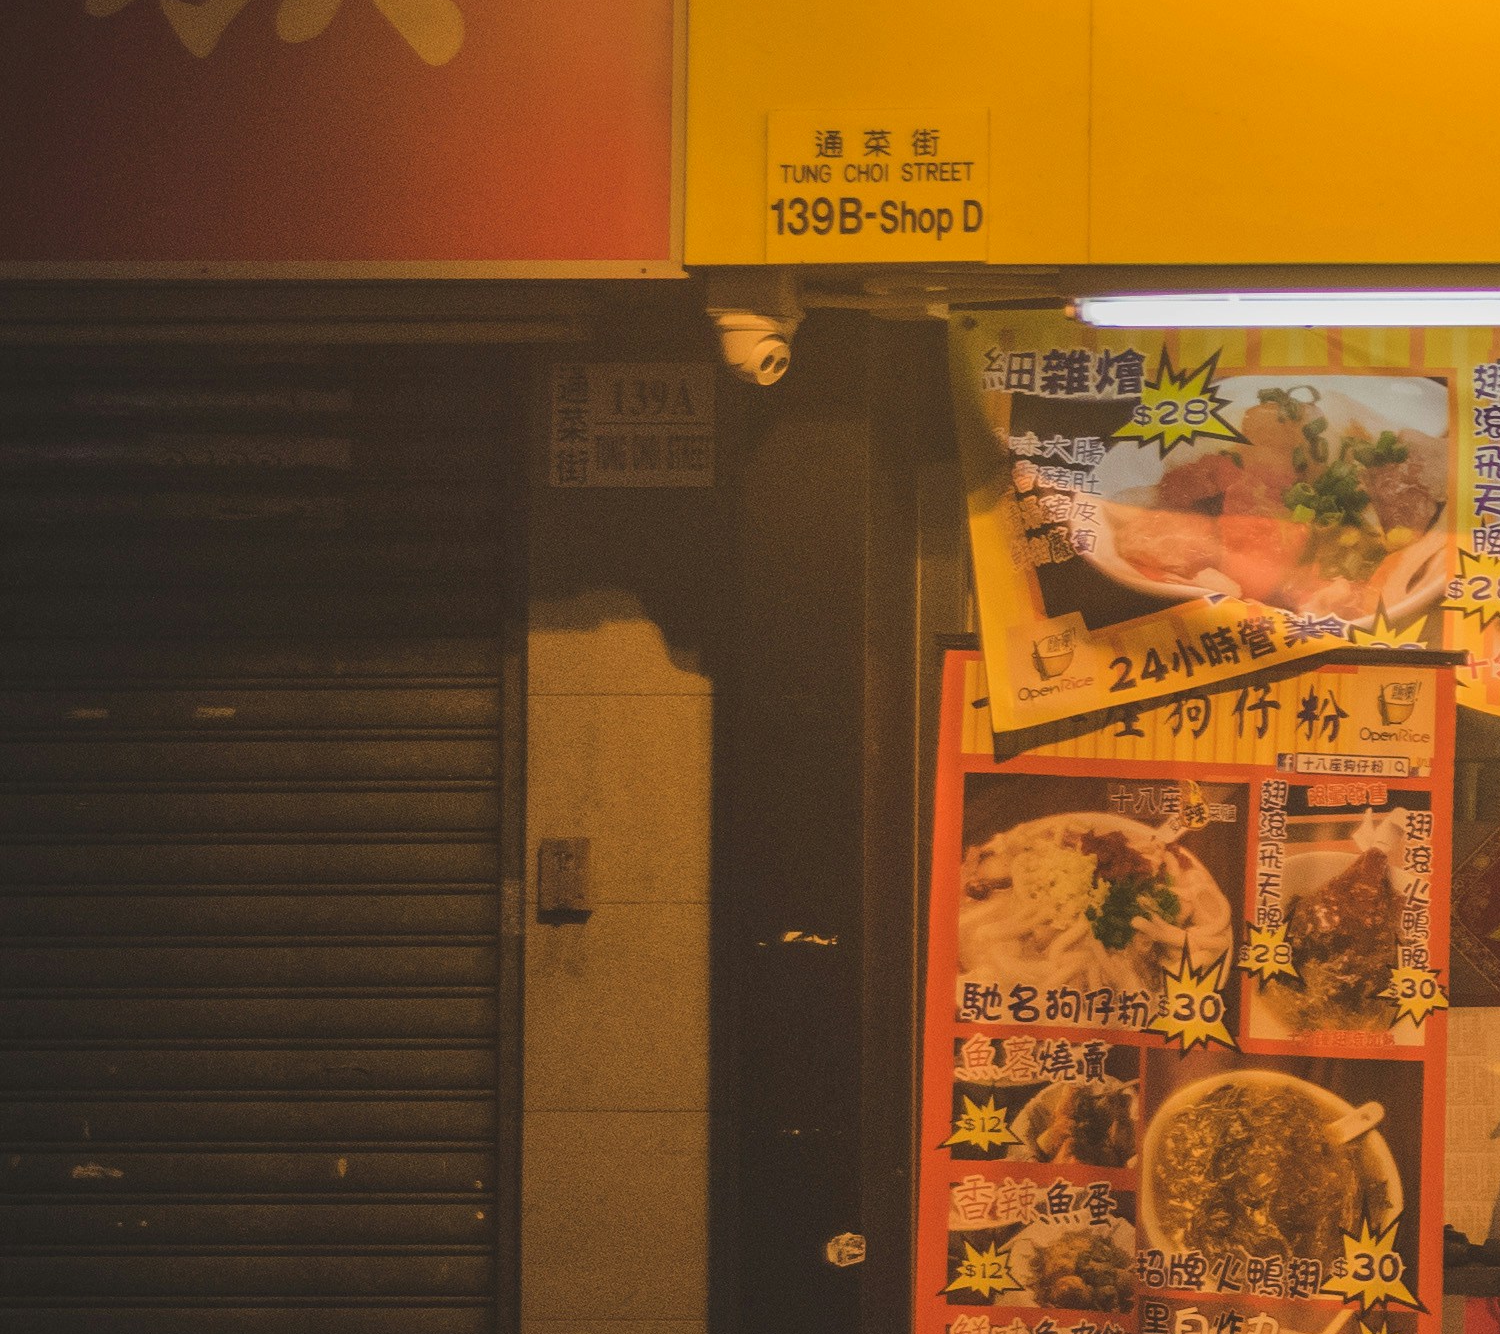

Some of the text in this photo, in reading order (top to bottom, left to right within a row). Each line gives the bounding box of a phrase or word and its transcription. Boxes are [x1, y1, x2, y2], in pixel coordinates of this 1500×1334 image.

[813, 130, 941, 162] 通菜街
[780, 161, 974, 183] TUNG CHOI STREET
[962, 200, 983, 234] D
[984, 348, 1146, 396] 細雜燴
[612, 378, 696, 416] 139A
[1132, 398, 1208, 428] $28
[1017, 673, 1095, 703] OpenRice
[1359, 727, 1431, 746] OpenRice
[1240, 943, 1291, 966] $28
[961, 982, 1149, 1027] 馳名狗仔粉
[1389, 979, 1436, 1002] $30
[1157, 993, 1224, 1023] $30
[957, 1037, 1109, 1084] 魚蓉燒賣
[963, 1115, 1001, 1134] $12
[952, 1177, 1118, 1229] 香辣魚蛋
[964, 1262, 1004, 1281] $12
[1136, 1249, 1323, 1300] 招牌火鴨翅
[1333, 1252, 1402, 1283] $30
